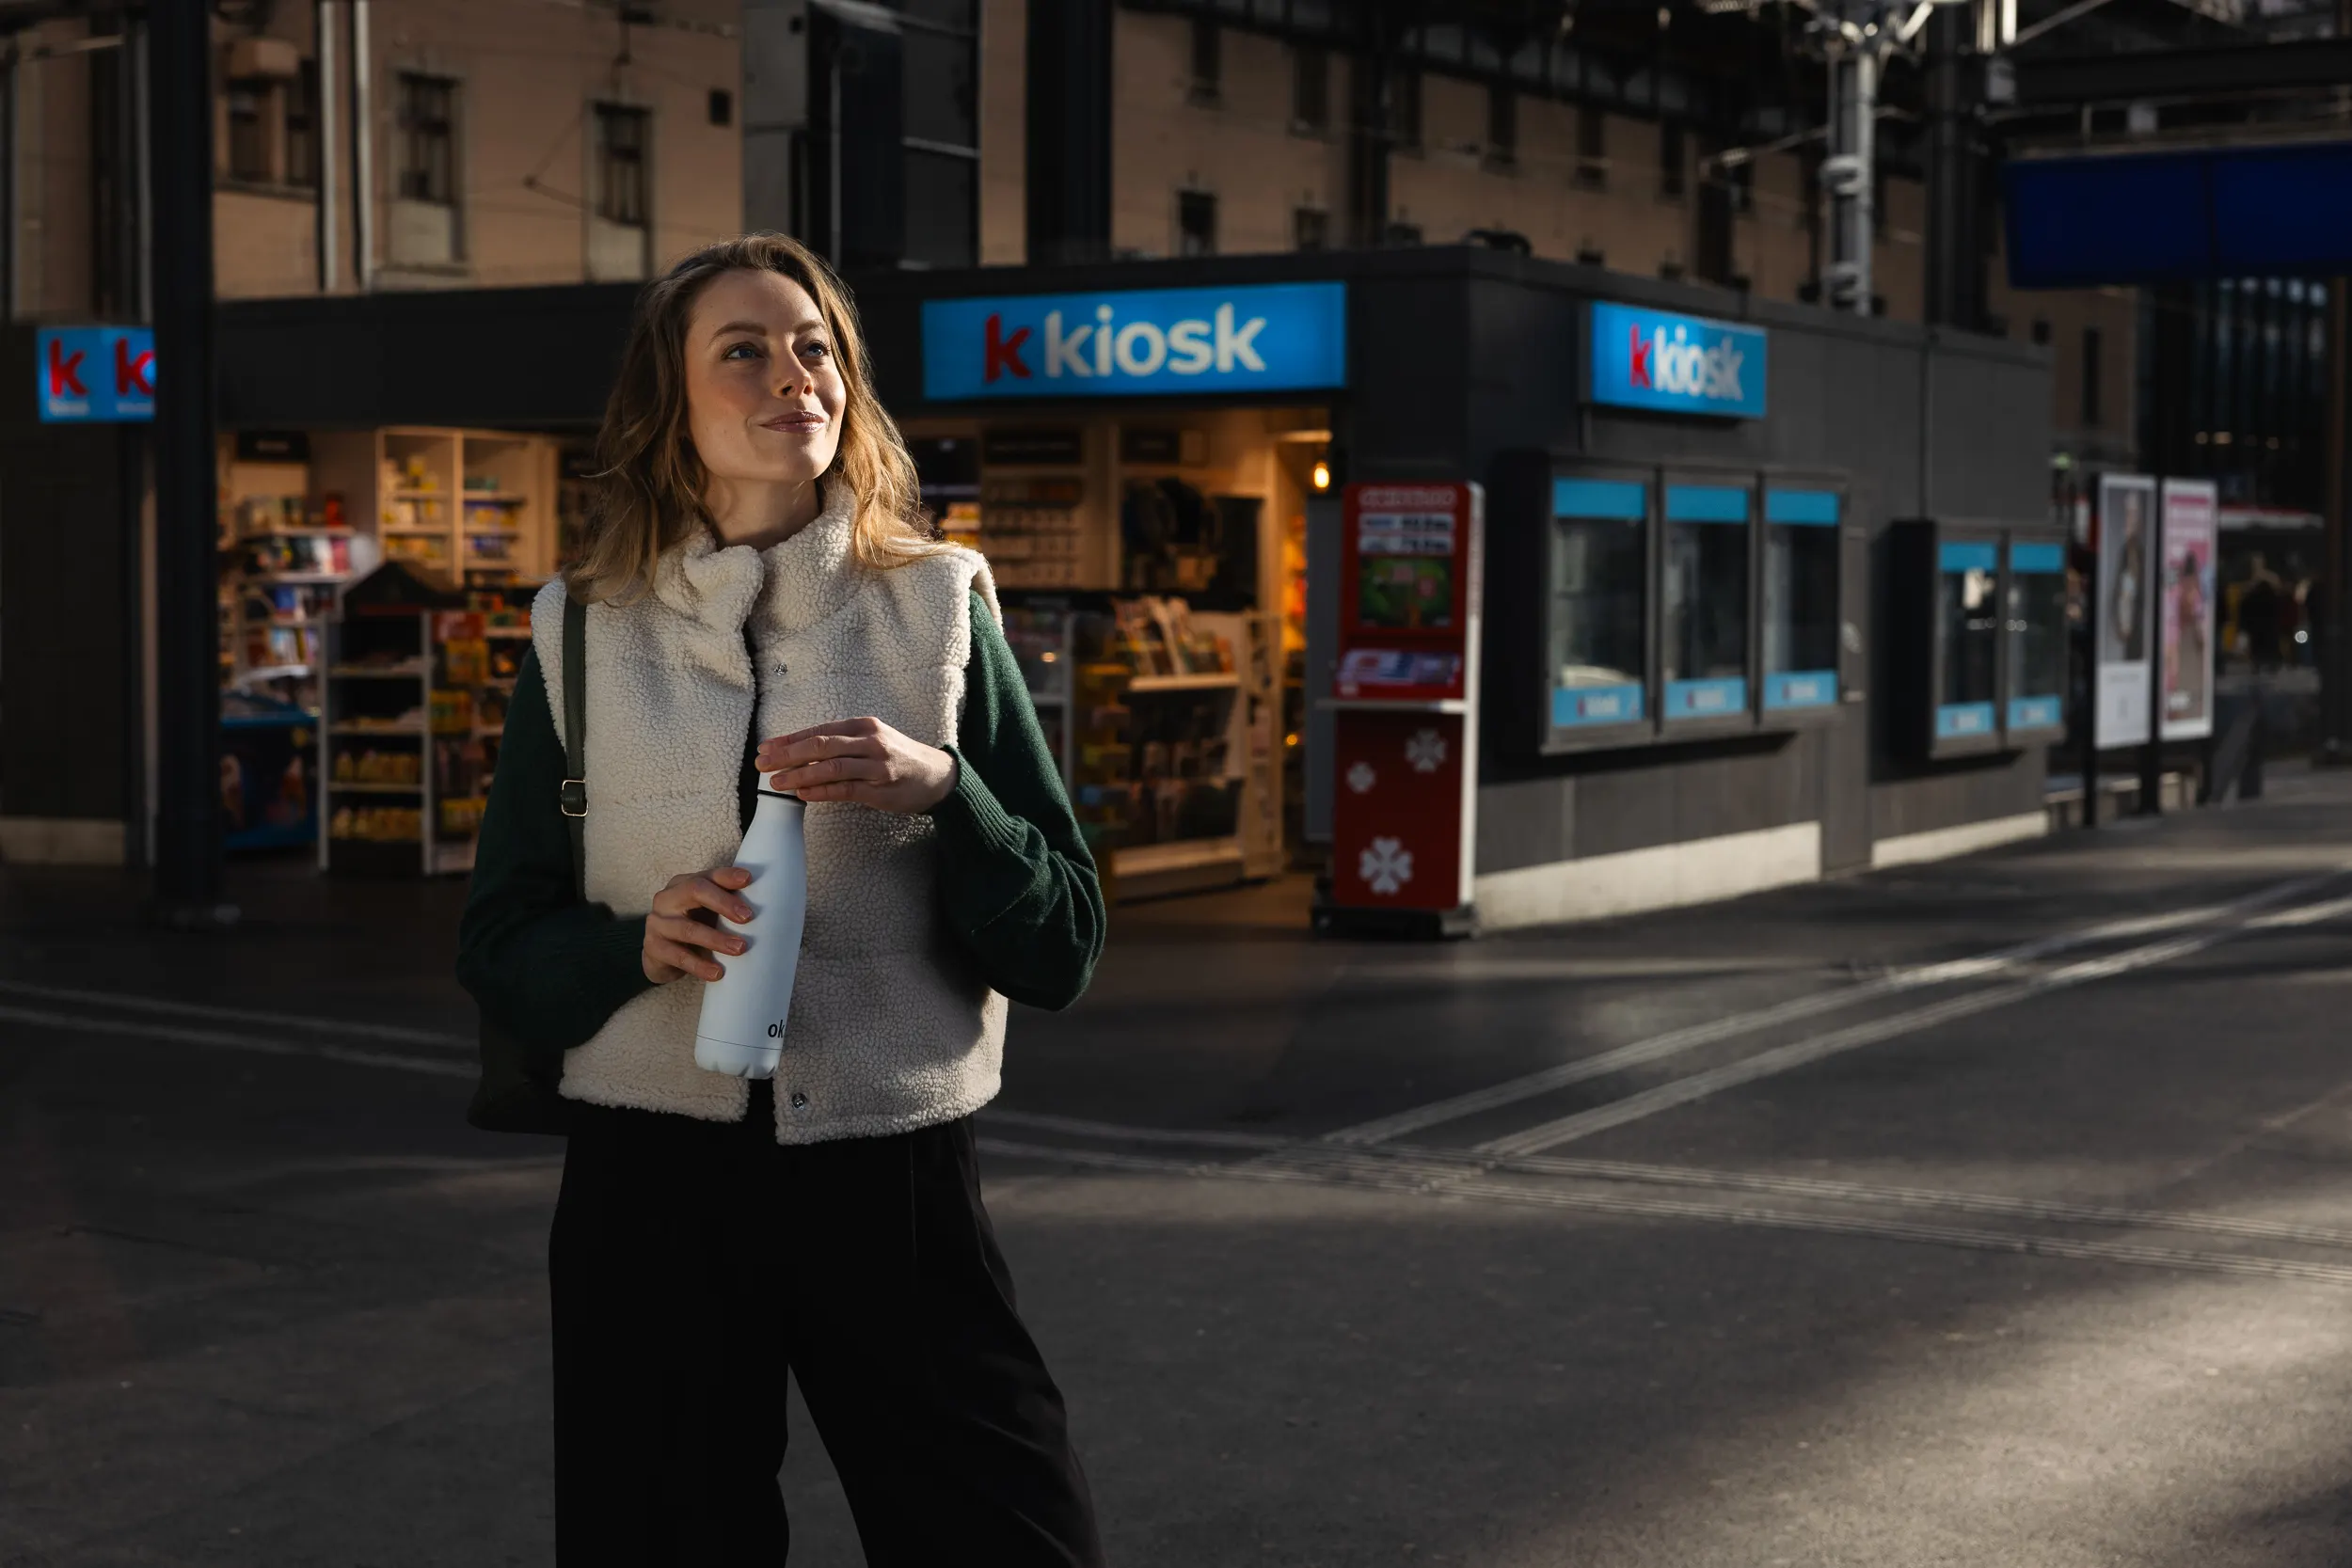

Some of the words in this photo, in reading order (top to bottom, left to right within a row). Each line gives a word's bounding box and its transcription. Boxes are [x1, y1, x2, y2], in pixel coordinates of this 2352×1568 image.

[49, 338, 89, 397] k
[984, 312, 1032, 384] k
[1044, 302, 1267, 378] kiosk
[1654, 324, 1744, 402] kiosk
